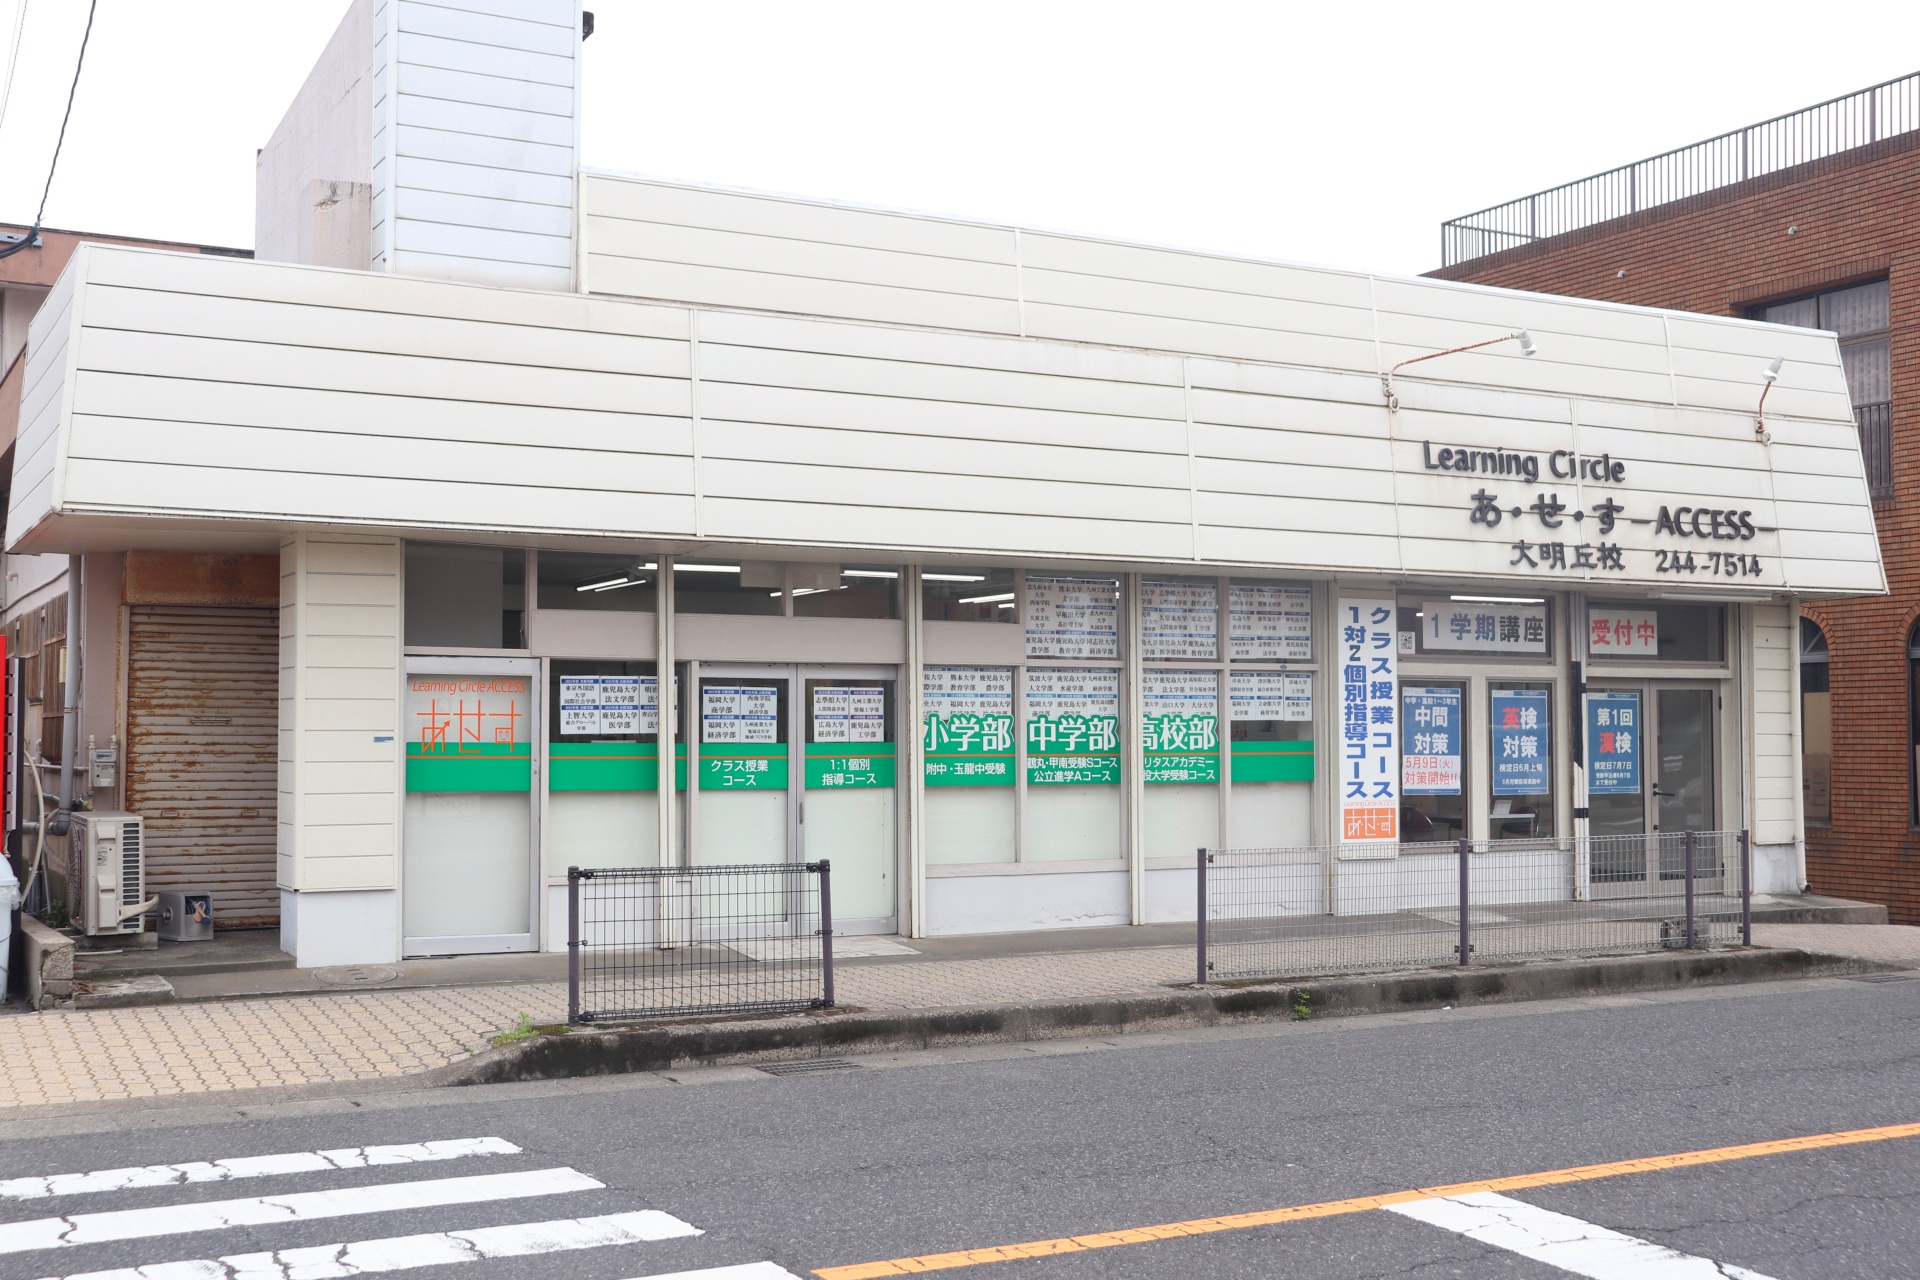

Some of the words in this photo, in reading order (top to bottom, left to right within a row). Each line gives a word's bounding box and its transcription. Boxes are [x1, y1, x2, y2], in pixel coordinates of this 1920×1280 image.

[1423, 440, 1539, 483] Learning
[1549, 449, 1626, 483] Circle
[1510, 539, 1626, 571] 大明丘校
[1655, 549, 1763, 578] 244-7514
[1431, 613, 1544, 643] 1学期講座
[1591, 619, 1655, 647] 受付中
[979, 674, 1011, 682] 鹿児島大学
[413, 679, 457, 695] Learning
[458, 679, 486, 693] Circle
[487, 680, 526, 693] ACCESS
[605, 695, 635, 703] 法文学部
[708, 696, 735, 704] 福岡大学
[950, 700, 976, 708] 福岡大学
[1343, 606, 1368, 798] 1対2個別指導コース
[1370, 606, 1393, 798] クラス授業コース
[566, 712, 595, 720] 上智大学
[602, 711, 638, 719] 鹿児島大学
[711, 706, 732, 714] 商学部
[1414, 705, 1448, 728] 中間
[1597, 707, 1633, 727] 第1回
[608, 721, 632, 729] 医学部
[1502, 706, 1538, 730] 英検
[707, 731, 736, 739] 経済学部
[818, 730, 845, 738] 経済学部
[924, 716, 1011, 751] 小学部
[1029, 717, 1116, 751] 中学部
[1143, 717, 1215, 750] 高校部
[1414, 732, 1448, 754] 対策
[1502, 735, 1538, 758] 対策
[1599, 731, 1632, 754] 漢検
[711, 759, 769, 772] クラス授業
[1499, 763, 1543, 773] 検定日6月上旬
[1594, 761, 1632, 770] 検定日7月7日
[723, 774, 757, 786] コース
[821, 772, 876, 786] 指導コース
[1034, 770, 1111, 782] 公立進学Aコース
